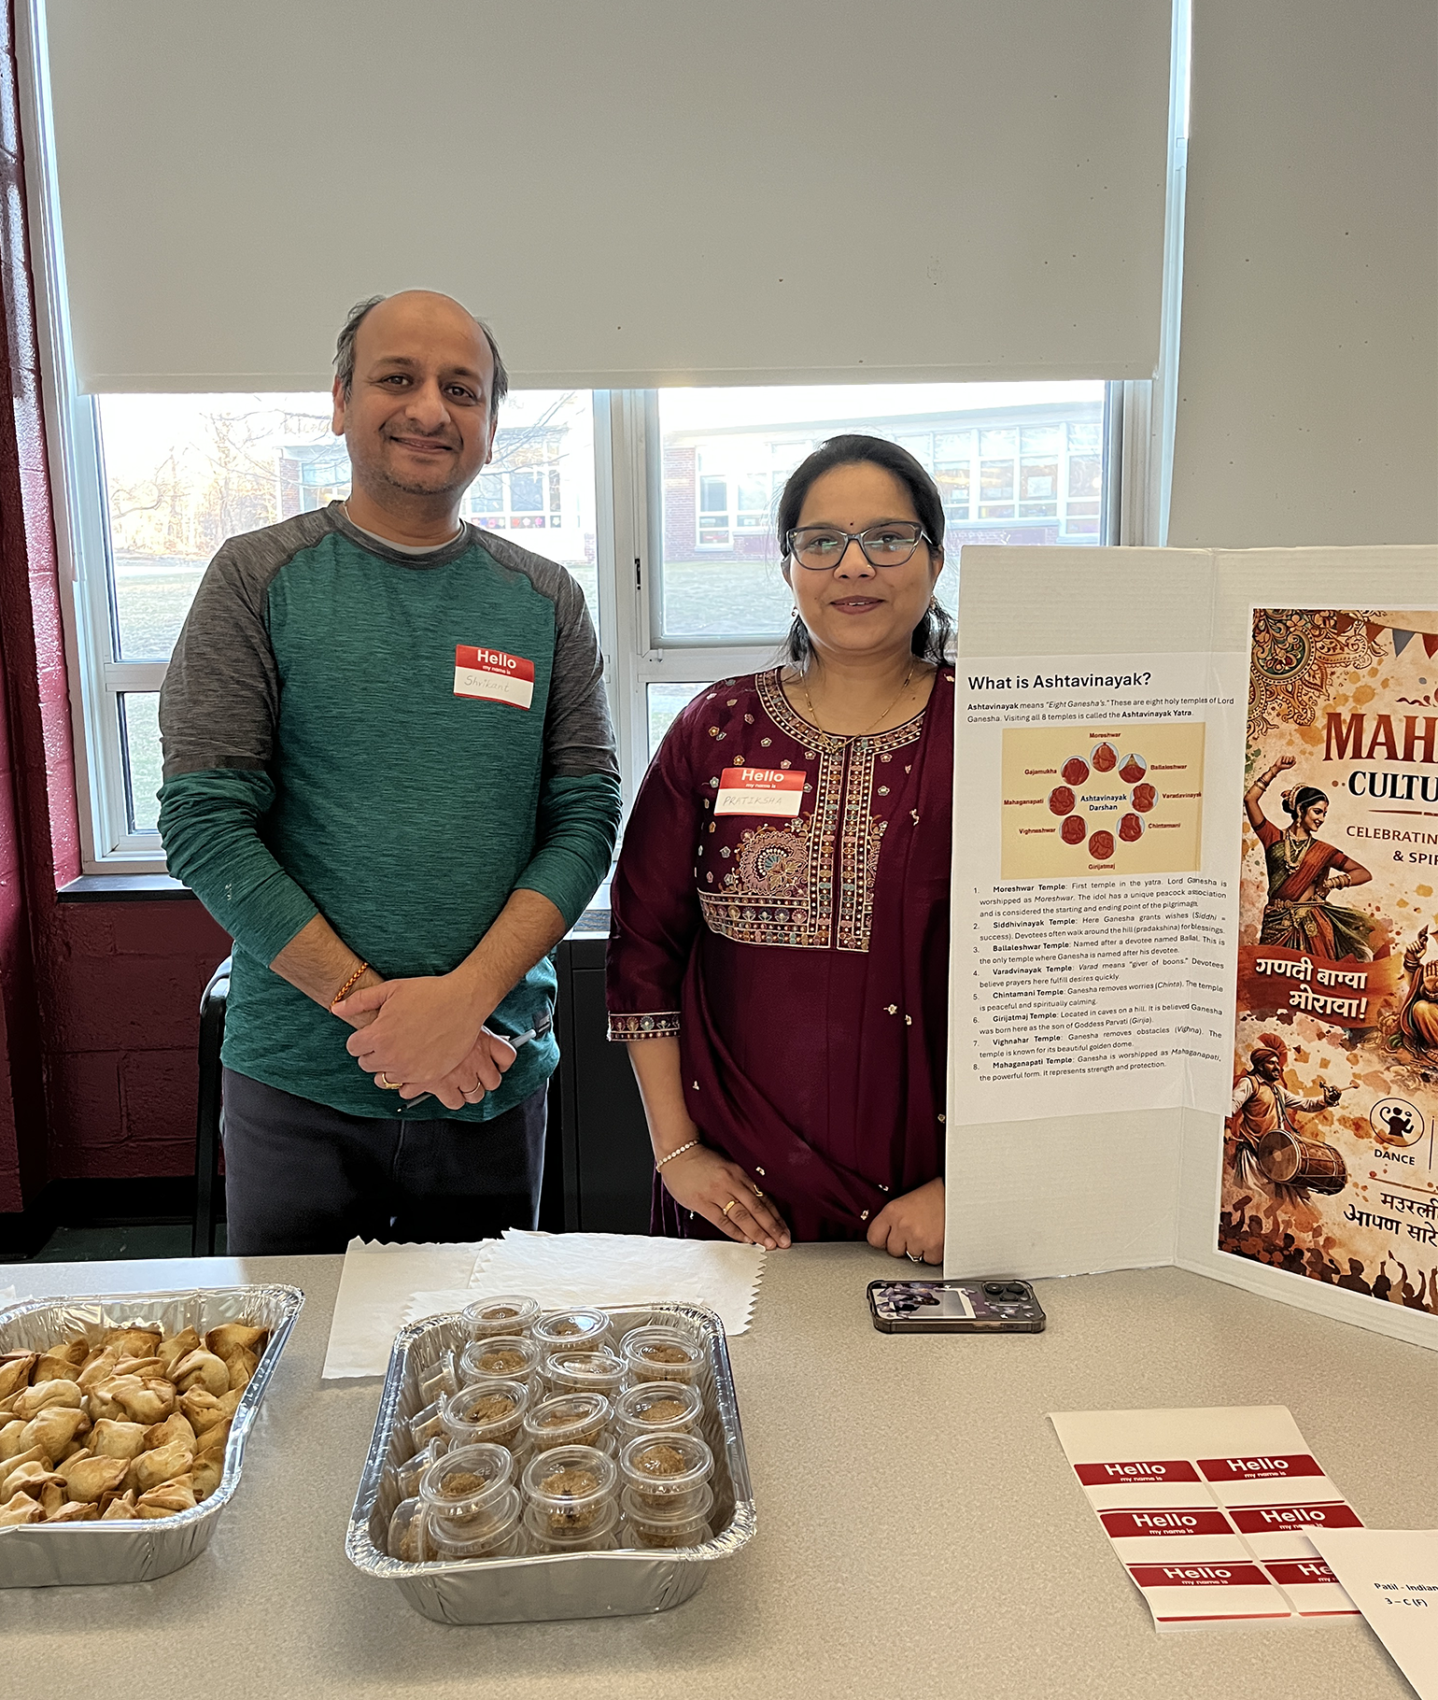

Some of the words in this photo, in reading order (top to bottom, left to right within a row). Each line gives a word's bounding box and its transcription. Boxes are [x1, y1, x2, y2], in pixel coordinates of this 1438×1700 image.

[478, 650, 516, 668] Hello
[968, 676, 1012, 690] What
[1016, 676, 1029, 689] is
[1033, 672, 1151, 689] Ashtavinayak?
[967, 702, 1019, 711] Ashtavinayak
[1146, 698, 1163, 707] eight
[1164, 698, 1180, 706] holy
[1004, 714, 1030, 722] Visiting
[1121, 710, 1172, 718] Ashtavinayak
[742, 770, 784, 782] Hello
[1349, 771, 1438, 802] CULTU
[1080, 794, 1127, 803] Ashtavinayak
[1347, 826, 1438, 844] CELEBRATIN
[1393, 850, 1404, 862] &
[1187, 876, 1217, 886] Ganesha
[979, 897, 1021, 906] worshipped
[1156, 889, 1186, 898] peacock
[993, 920, 1044, 929] Siddhivinayak
[1139, 914, 1161, 922] grants
[1202, 935, 1217, 944] This
[992, 967, 1042, 975] Varadvinayak
[1191, 957, 1224, 969] Devotees
[992, 990, 1036, 999] Chintamani
[1067, 987, 1098, 995] Ganesha
[1186, 979, 1197, 988] The
[1198, 982, 1223, 992] temple
[992, 1058, 1044, 1069] Mahaganapati
[1077, 1054, 1108, 1063] Ganesha
[1118, 1050, 1158, 1059] worshipped
[1374, 1149, 1415, 1165] DANCE
[1104, 1463, 1166, 1475] Hello
[1226, 1458, 1289, 1471] Hello
[1132, 1514, 1197, 1527] Hello
[1260, 1509, 1325, 1522] Hello
[1163, 1568, 1232, 1578] Hello
[1412, 1599, 1428, 1607] (F)
